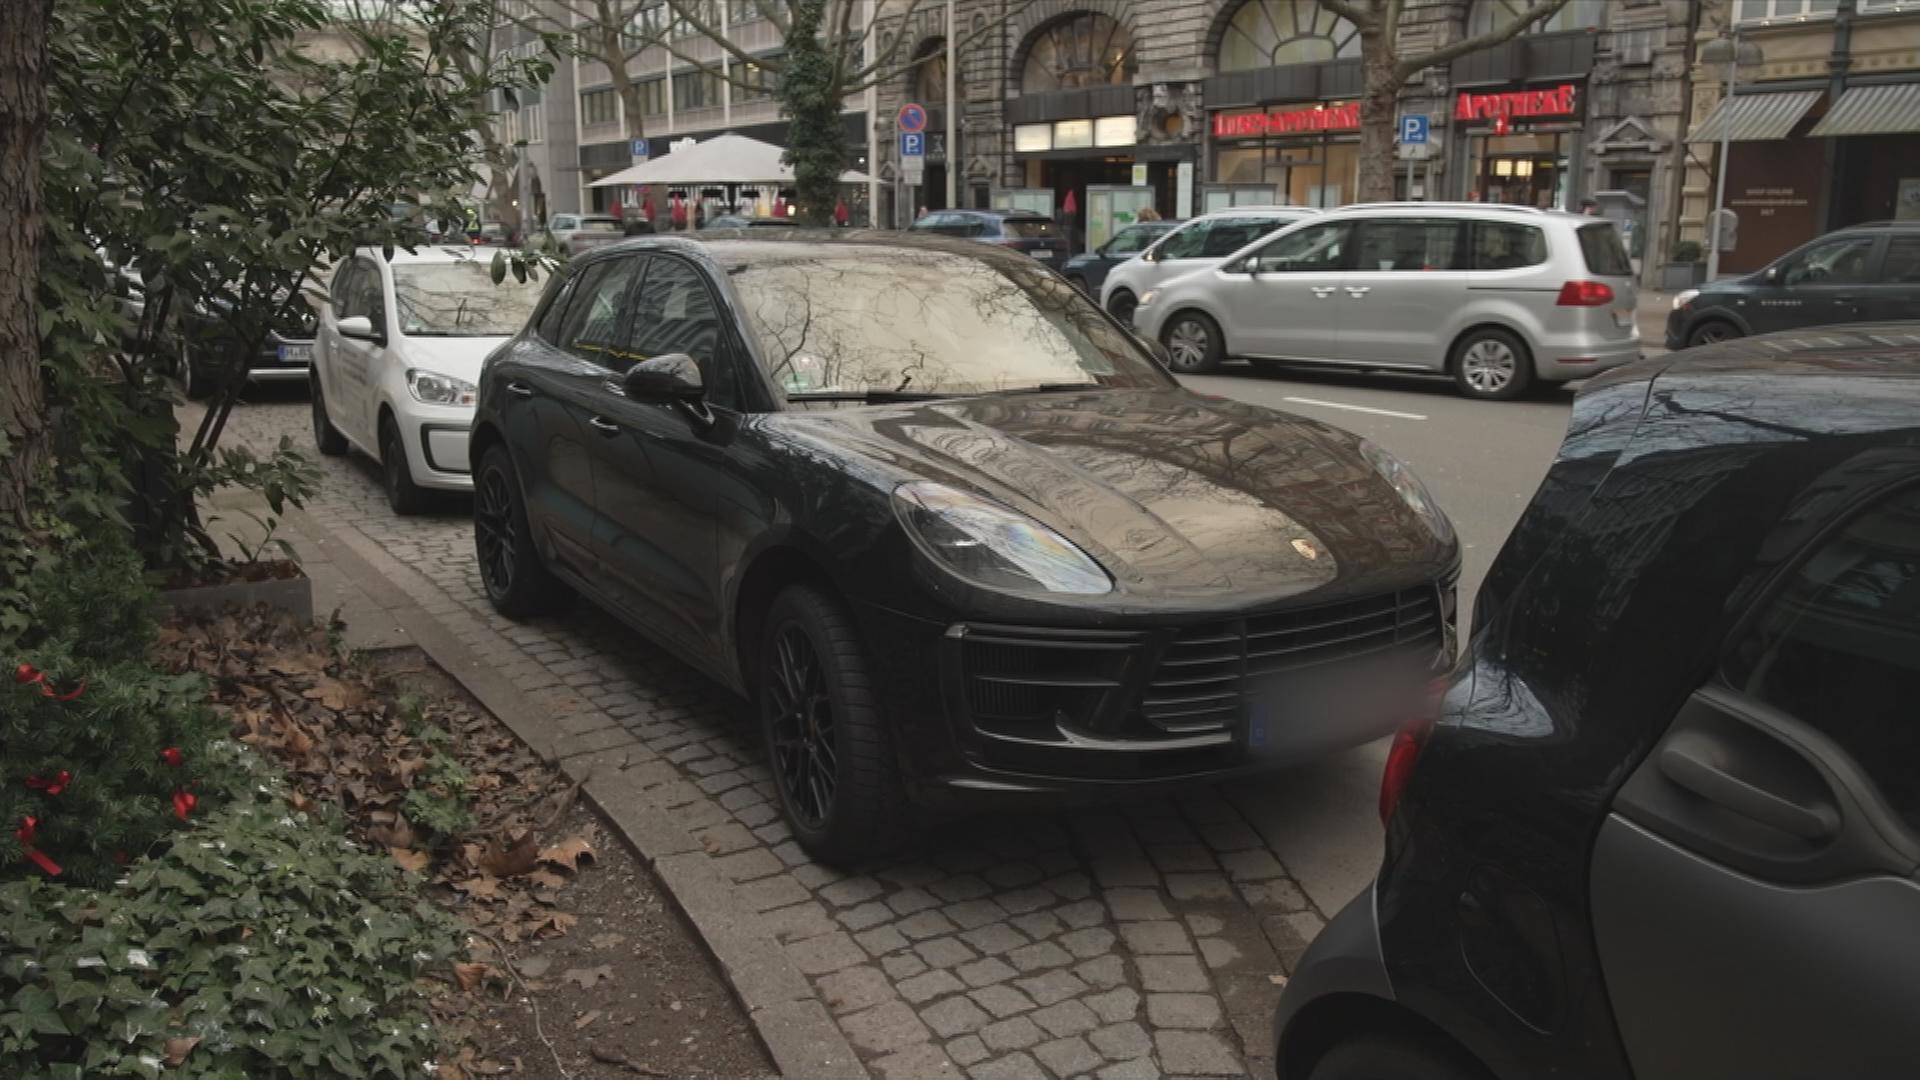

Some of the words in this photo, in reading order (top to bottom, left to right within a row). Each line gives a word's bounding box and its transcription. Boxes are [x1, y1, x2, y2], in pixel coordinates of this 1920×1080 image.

[1455, 85, 1576, 121] APOTHEKE
[1404, 119, 1421, 141] P
[905, 134, 919, 153] P
